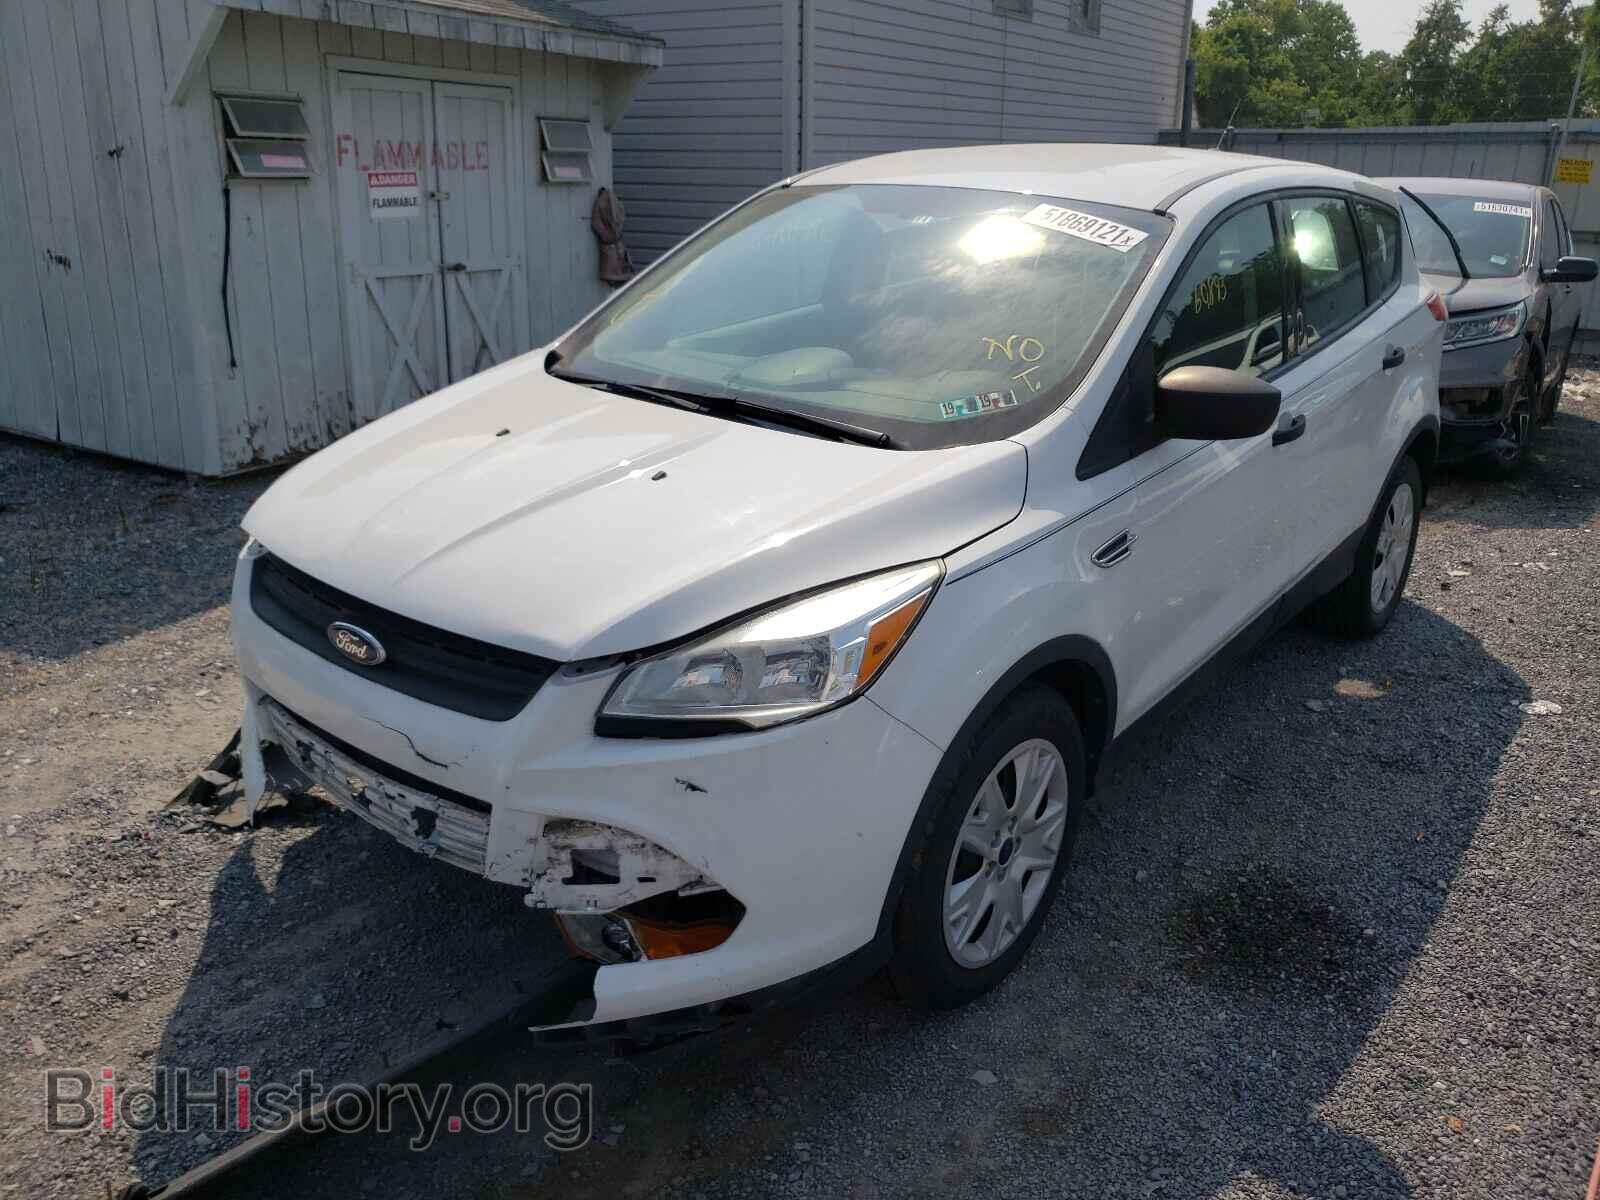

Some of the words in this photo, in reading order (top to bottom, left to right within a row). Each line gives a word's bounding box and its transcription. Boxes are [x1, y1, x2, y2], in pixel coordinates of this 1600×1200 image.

[336, 133, 489, 172] FLAMMABLE
[379, 174, 416, 185] DANGER
[372, 196, 417, 209] FLAMMABLE
[982, 334, 1045, 362] NO
[942, 401, 955, 416] 19
[979, 394, 992, 409] 19
[336, 630, 369, 659] Ford
